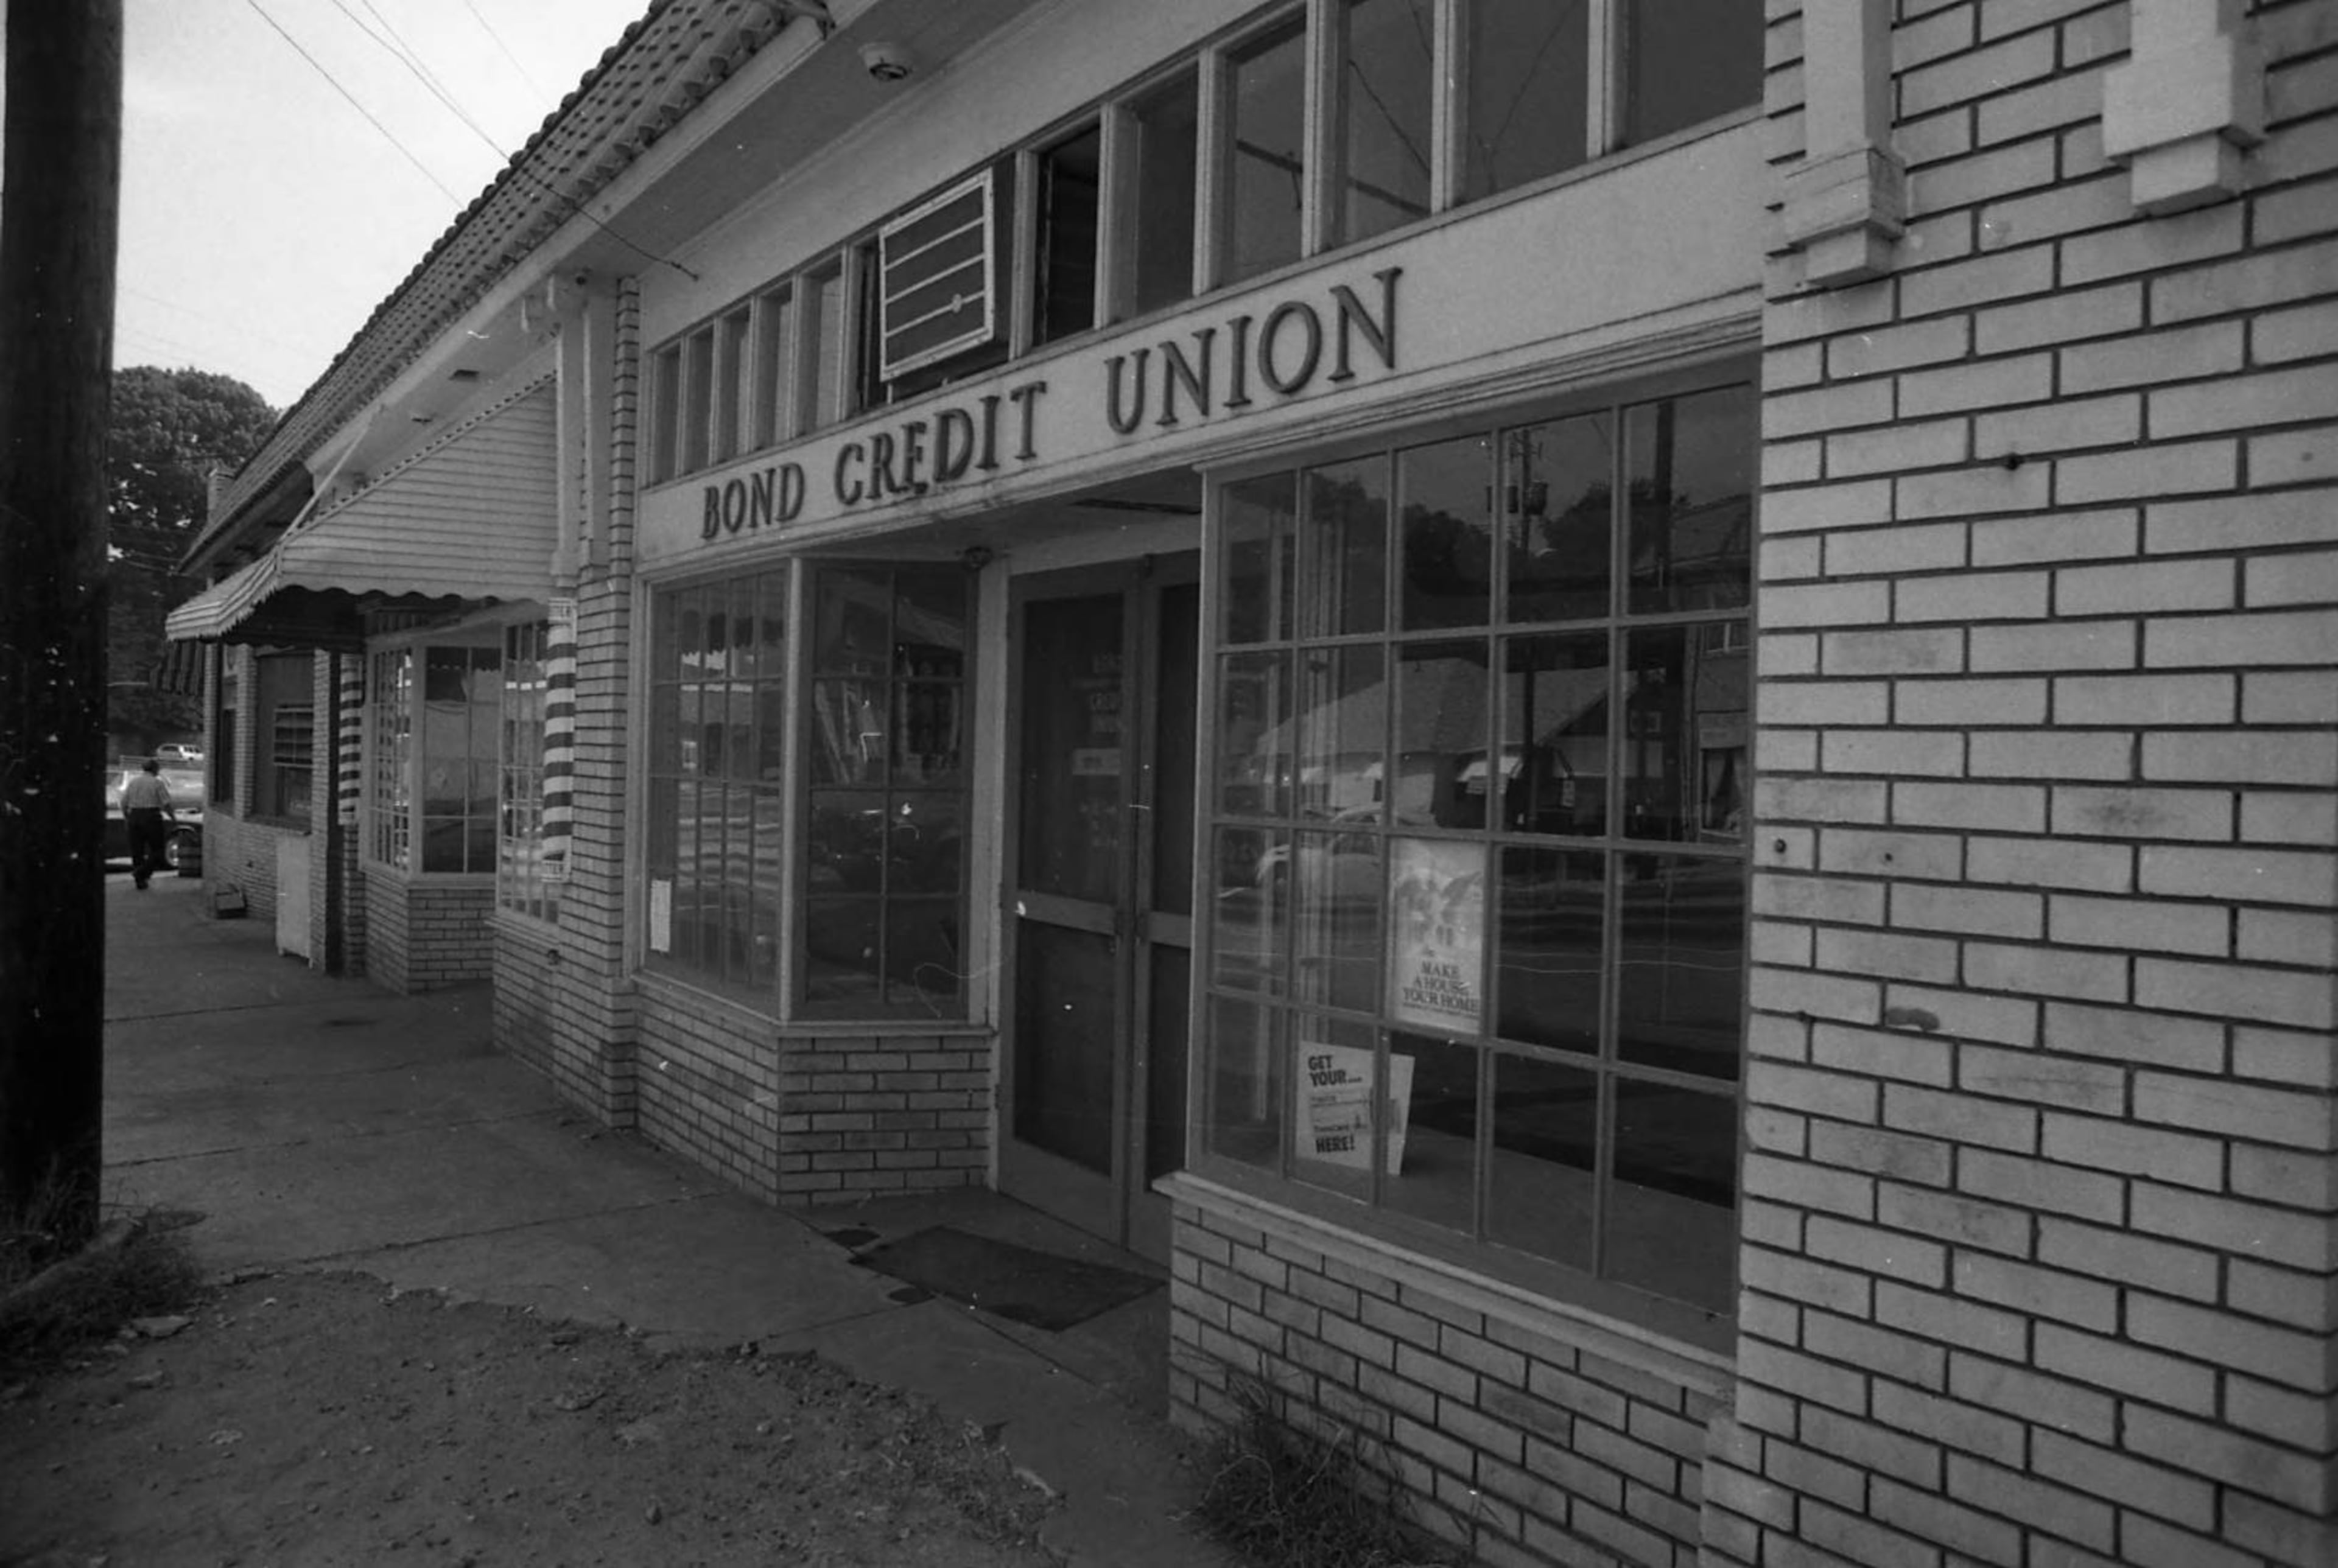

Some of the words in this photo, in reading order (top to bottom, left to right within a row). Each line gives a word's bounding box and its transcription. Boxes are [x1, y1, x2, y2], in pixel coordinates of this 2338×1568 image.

[700, 462, 806, 540] BOND
[834, 380, 1047, 506] CREDIT
[1103, 267, 1404, 435] UNION
[1422, 961, 1460, 979] MAKE
[1403, 987, 1438, 1006] YOUR
[1441, 993, 1480, 1013] HOME
[1308, 1055, 1333, 1070] GET
[1316, 1134, 1356, 1153] HERE!
